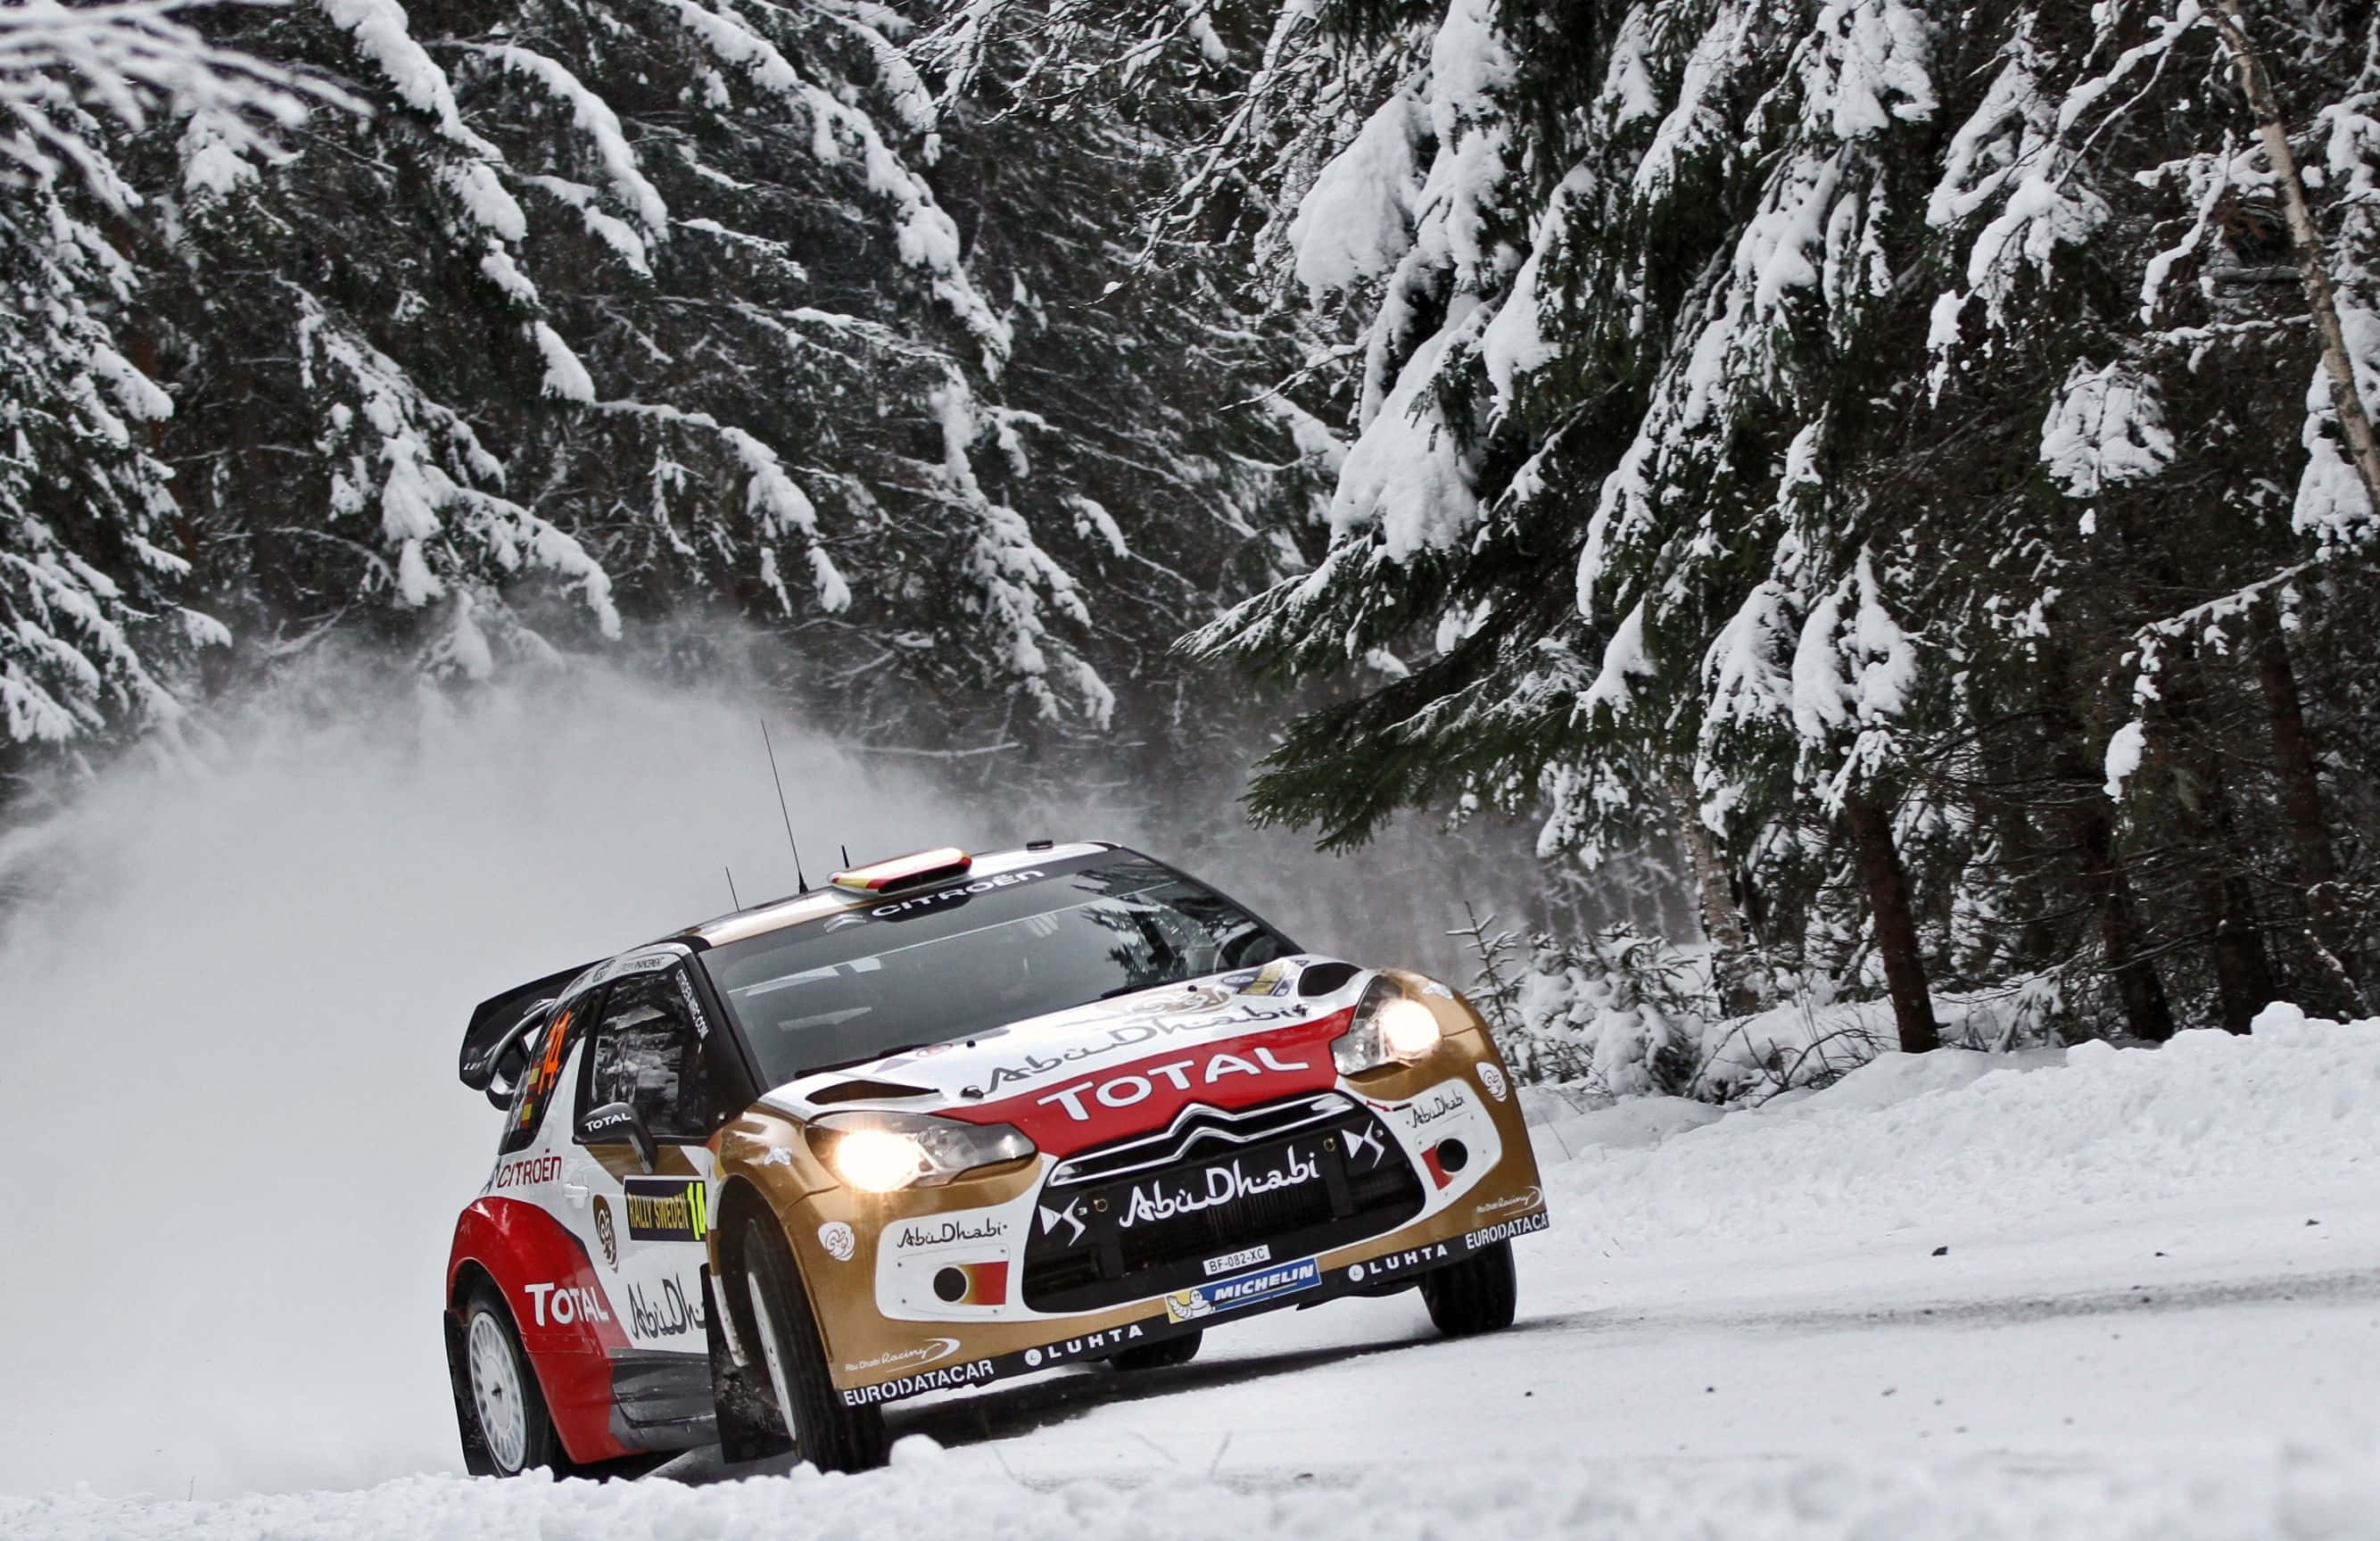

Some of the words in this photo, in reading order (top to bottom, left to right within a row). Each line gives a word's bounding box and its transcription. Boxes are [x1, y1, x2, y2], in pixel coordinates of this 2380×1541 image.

[872, 870, 1045, 916] CITROËN
[1037, 1047, 1309, 1122] TOTAL
[585, 1113, 632, 1132] TOTAL
[498, 1148, 562, 1188] CITROËN
[626, 1192, 652, 1229] RALLY
[654, 1192, 690, 1229] SWEDEN
[1465, 1213, 1548, 1249] EURODATACA
[1209, 1248, 1265, 1272] BF-082-XC
[1369, 1244, 1448, 1274] LUHTA
[1214, 1263, 1314, 1301] MICHELIN
[525, 1282, 609, 1327] TOTAL
[1047, 1324, 1144, 1358] LUHTA
[843, 1359, 995, 1406] EURODATACAR
